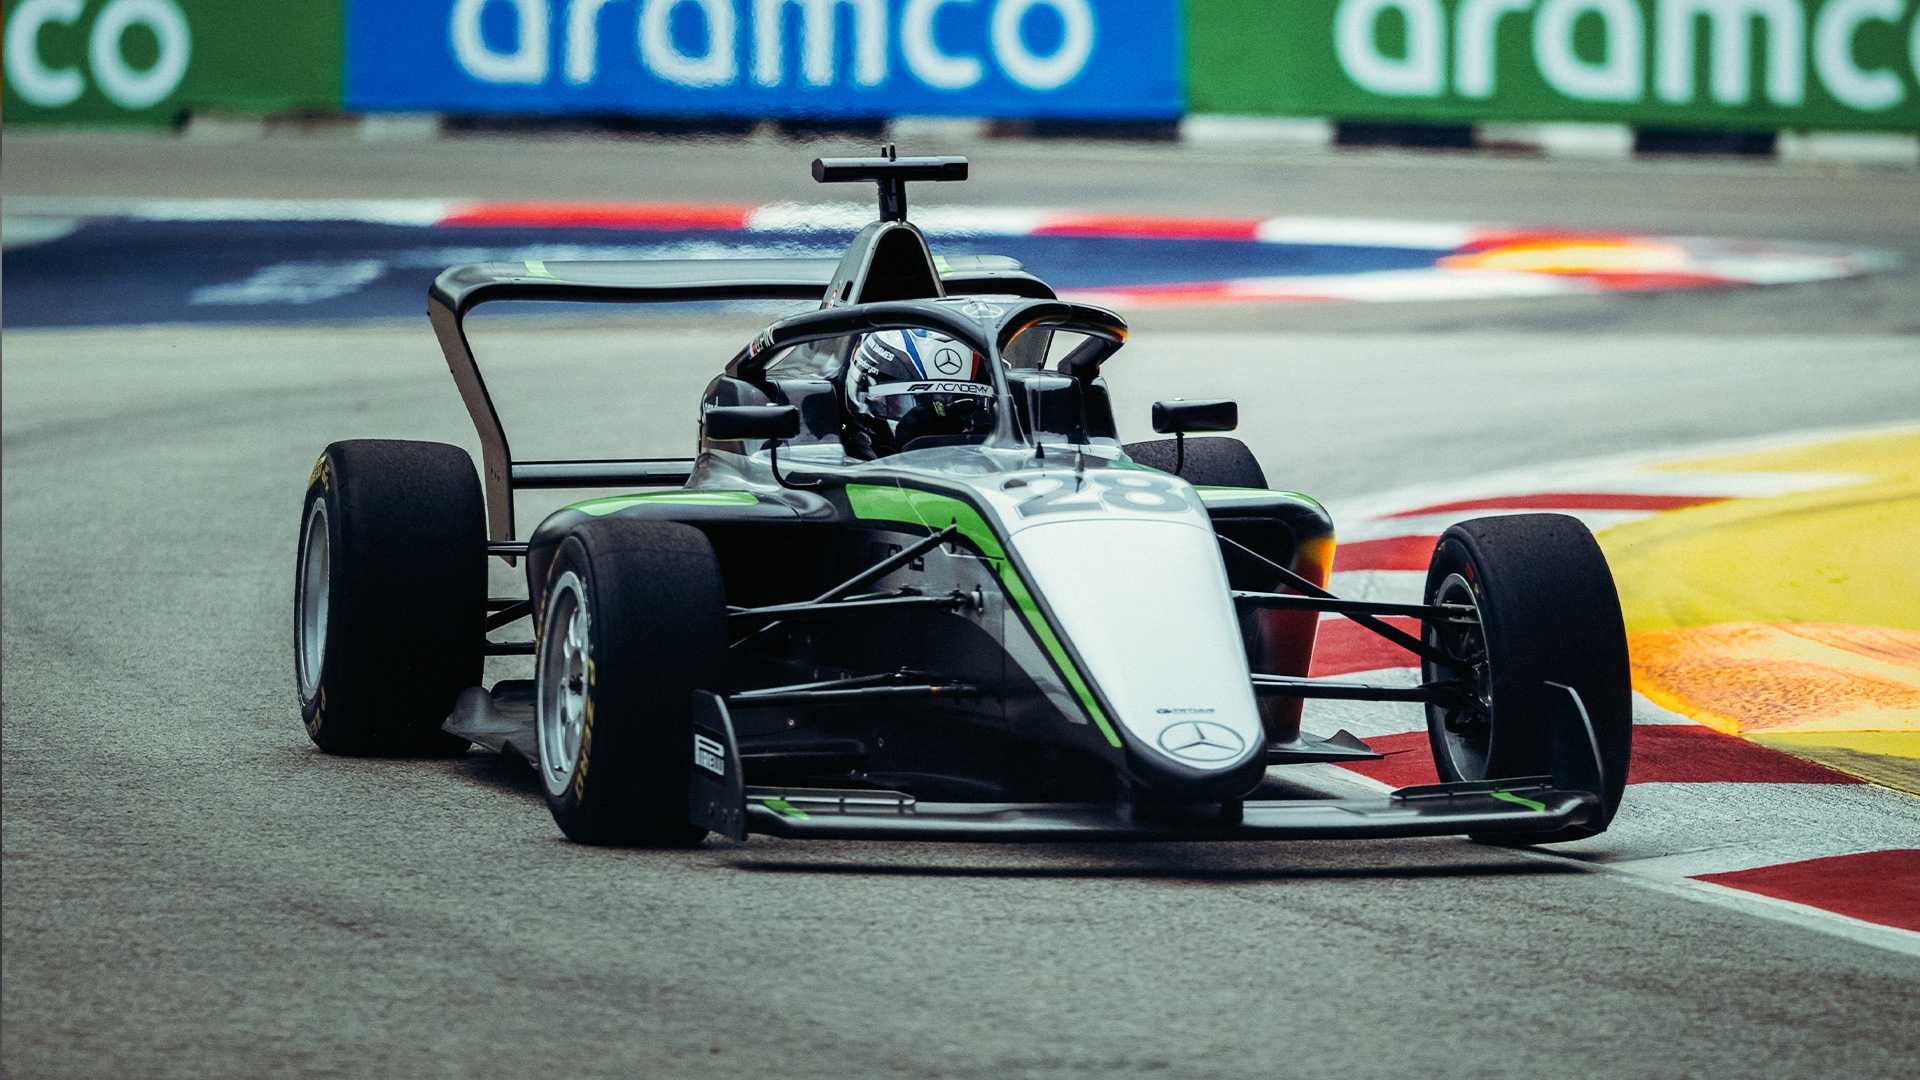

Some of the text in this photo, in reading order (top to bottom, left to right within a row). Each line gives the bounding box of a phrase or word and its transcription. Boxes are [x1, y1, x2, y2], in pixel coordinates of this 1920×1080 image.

[451, 0, 1095, 90] aramco
[1334, 0, 1920, 108] aramc
[935, 382, 988, 393] ACADEMY
[1000, 472, 1192, 519] 28
